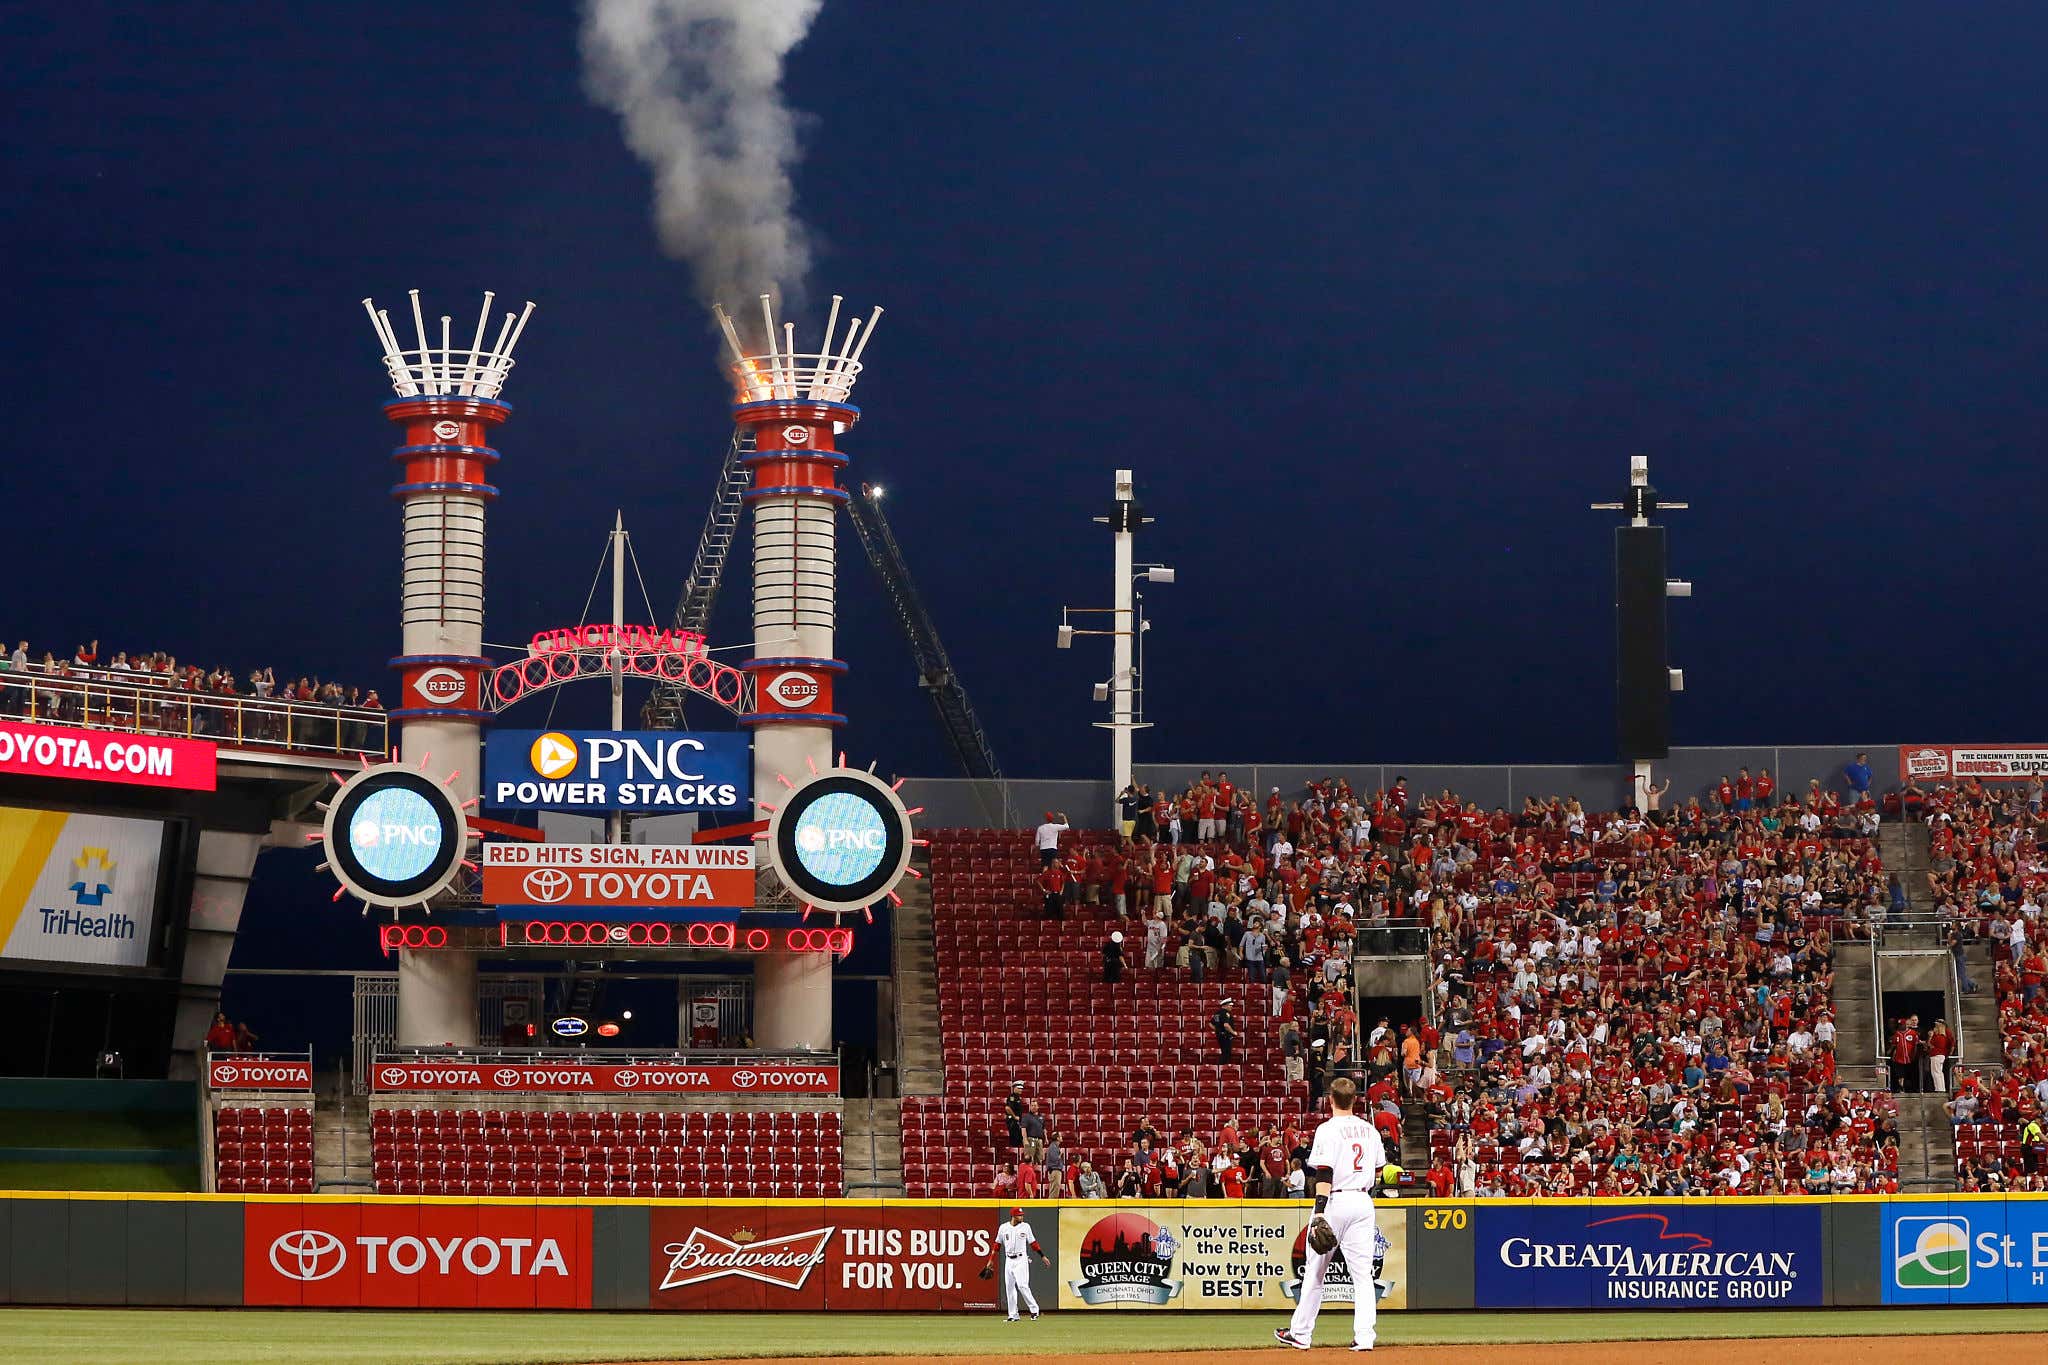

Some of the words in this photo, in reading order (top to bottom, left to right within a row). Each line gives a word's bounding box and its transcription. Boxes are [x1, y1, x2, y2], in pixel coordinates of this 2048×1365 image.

[531, 624, 707, 657] CINCINNATI
[583, 738, 705, 781] PNC
[497, 782, 606, 804] POWER
[618, 783, 737, 806] STACKS
[382, 824, 437, 846] PNC
[825, 828, 882, 850] PNC
[489, 846, 530, 863] RED
[536, 847, 583, 864] HITS
[590, 847, 645, 866] SIGN,
[651, 848, 689, 865] FAN
[695, 848, 749, 866] WINS
[578, 872, 715, 900] TOYOTA
[40, 908, 135, 939] TriHealth
[241, 1067, 309, 1082] TOYOTA
[410, 1070, 481, 1084] TOYOTA
[523, 1071, 593, 1085] TOYOTA
[642, 1071, 710, 1085] TOYOTA
[760, 1071, 828, 1085] TOYOTA
[1352, 1143, 1364, 1172] 2
[1181, 1225, 1237, 1238] You've
[1243, 1224, 1285, 1238] Tried
[1424, 1209, 1467, 1231] 370
[842, 1229, 903, 1256] THIS
[910, 1229, 990, 1257] BUD'S
[1197, 1241, 1223, 1254] the
[1229, 1241, 1269, 1256] Rest,
[1975, 1232, 2023, 1269] St.
[356, 1236, 569, 1276] TOYOTA
[663, 1242, 825, 1270] Budweiser
[1500, 1237, 1622, 1268] GREAT
[1608, 1246, 1796, 1277] AMERICAN
[842, 1262, 893, 1289] FOR
[900, 1262, 962, 1290] YOU.
[1085, 1261, 1132, 1277] QUEEN
[1134, 1261, 1168, 1277] CITY
[1101, 1274, 1151, 1284] SAUSAGE
[1182, 1262, 1220, 1276] Now
[1226, 1262, 1250, 1278] try
[1256, 1261, 1284, 1276] the
[1096, 1285, 1136, 1295] CINCINNATI,
[1137, 1287, 1155, 1295] OHIO
[1202, 1280, 1264, 1297] BEST!
[1608, 1280, 1719, 1299] INSURANCE
[1727, 1280, 1793, 1299] GROUP
